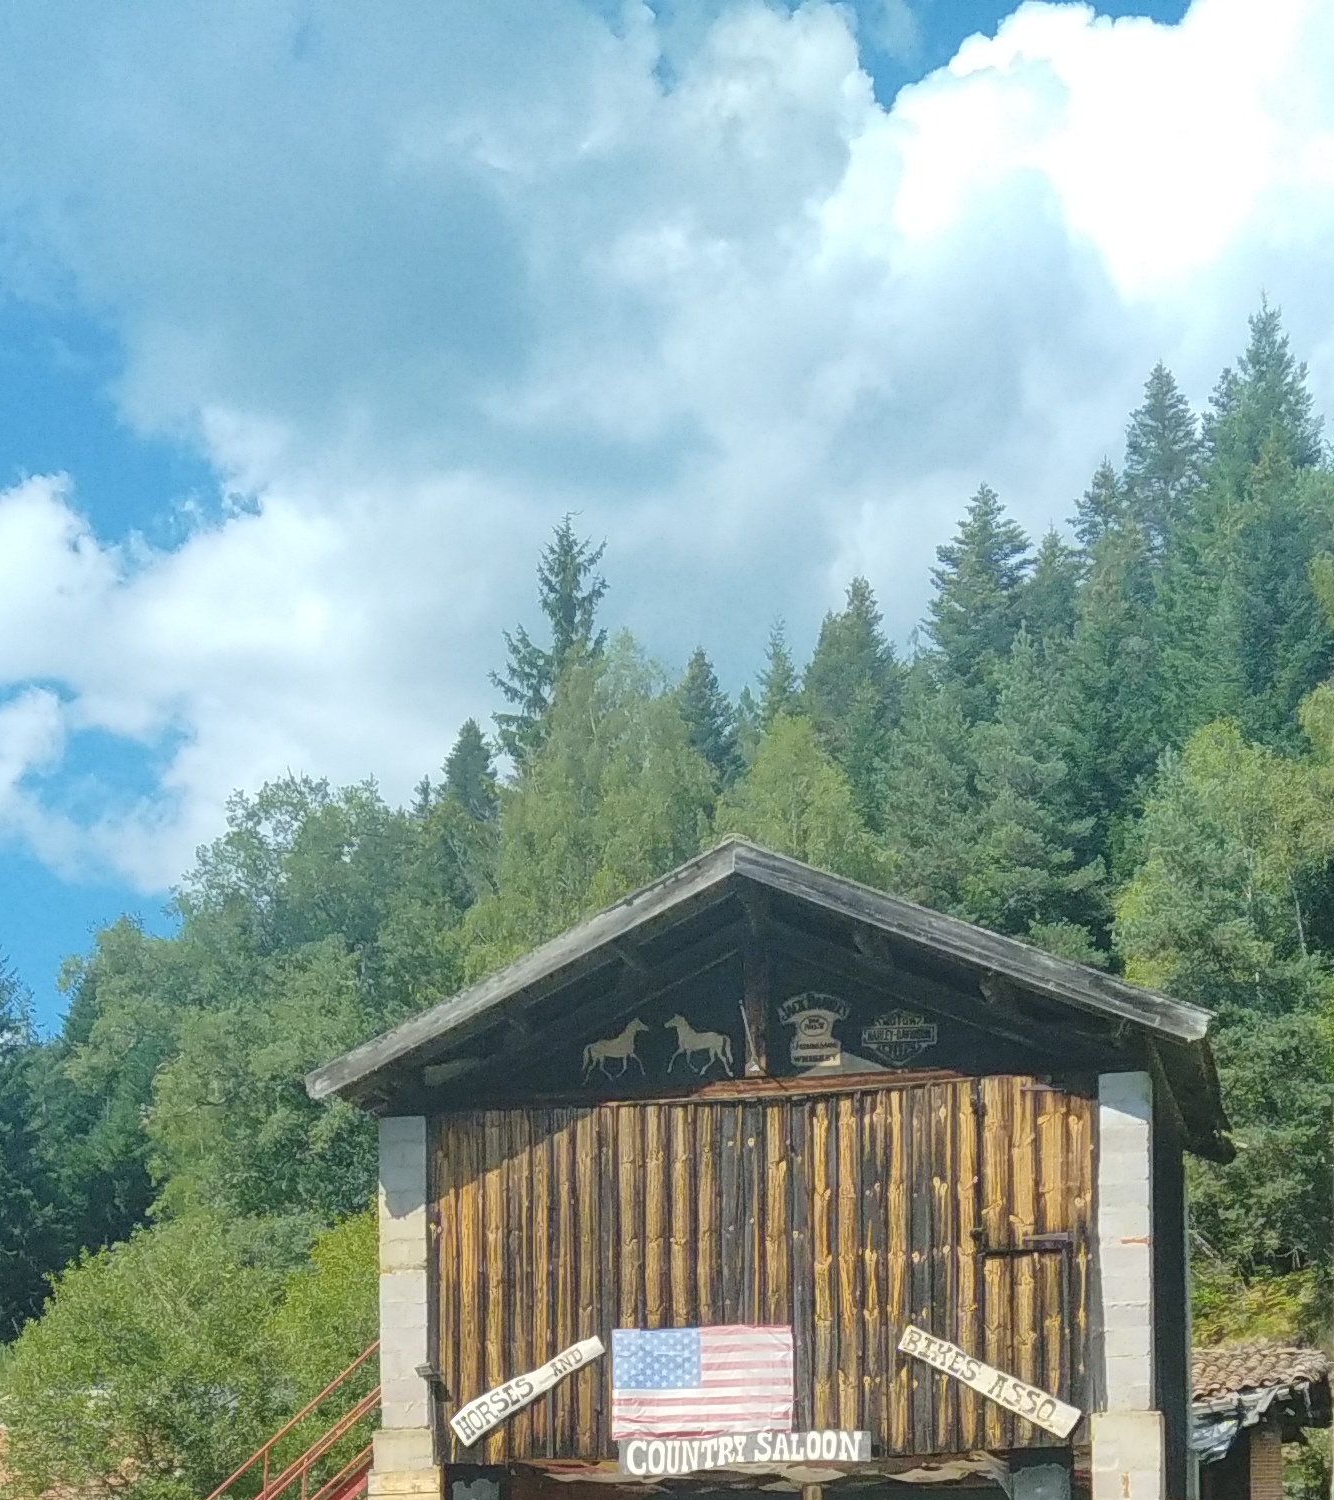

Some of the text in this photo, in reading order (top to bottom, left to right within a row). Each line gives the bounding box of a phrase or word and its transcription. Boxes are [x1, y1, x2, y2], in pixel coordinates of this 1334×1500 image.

[902, 1329, 983, 1382] BIKES
[455, 1377, 534, 1440] HORSES
[626, 1428, 862, 1475] COUNTRY SALOON
